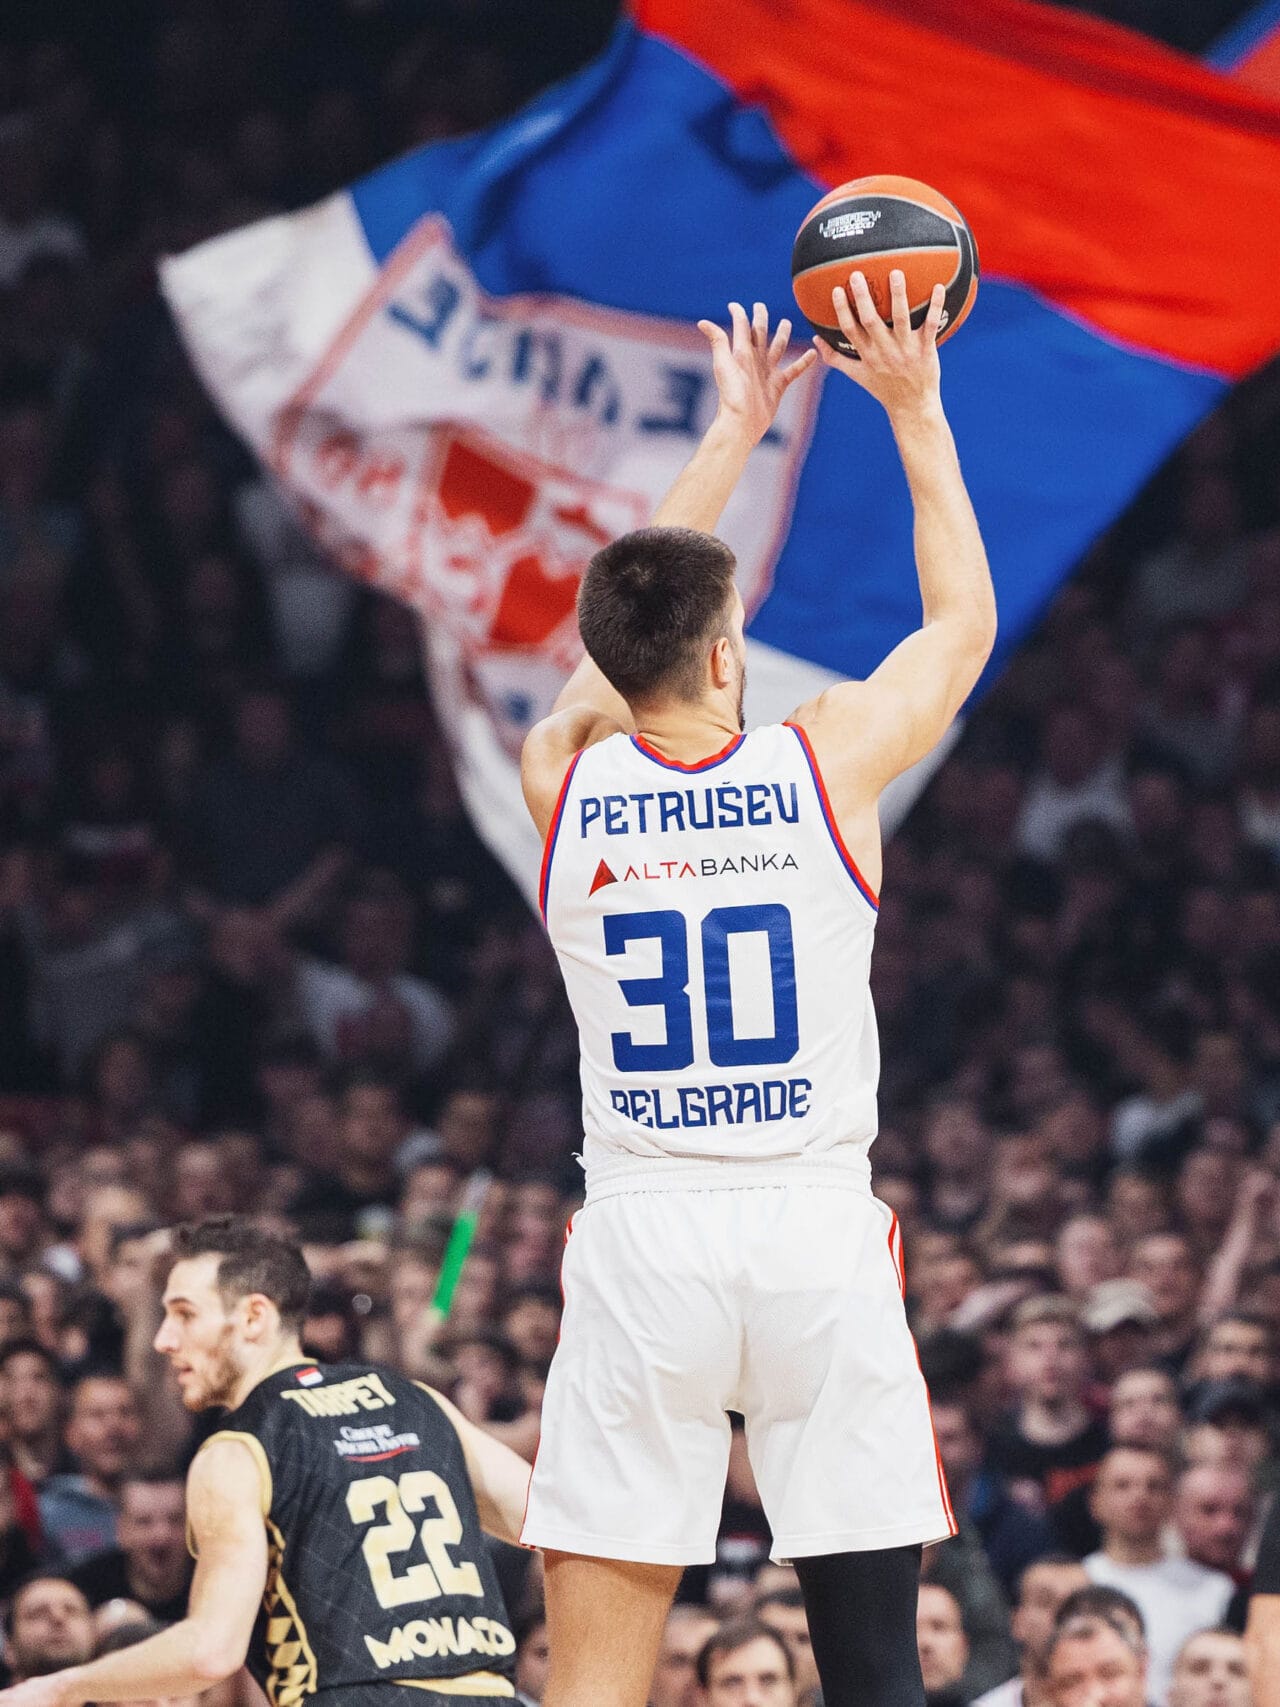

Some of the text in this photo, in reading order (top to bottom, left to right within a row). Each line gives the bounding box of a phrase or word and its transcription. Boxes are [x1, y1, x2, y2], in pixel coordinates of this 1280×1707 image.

[579, 781, 800, 839] PETRUŠEV
[602, 903, 800, 1073] 30
[610, 1077, 813, 1130] BELGRADE
[346, 1470, 485, 1610] 22
[363, 1616, 517, 1670] MONACO
